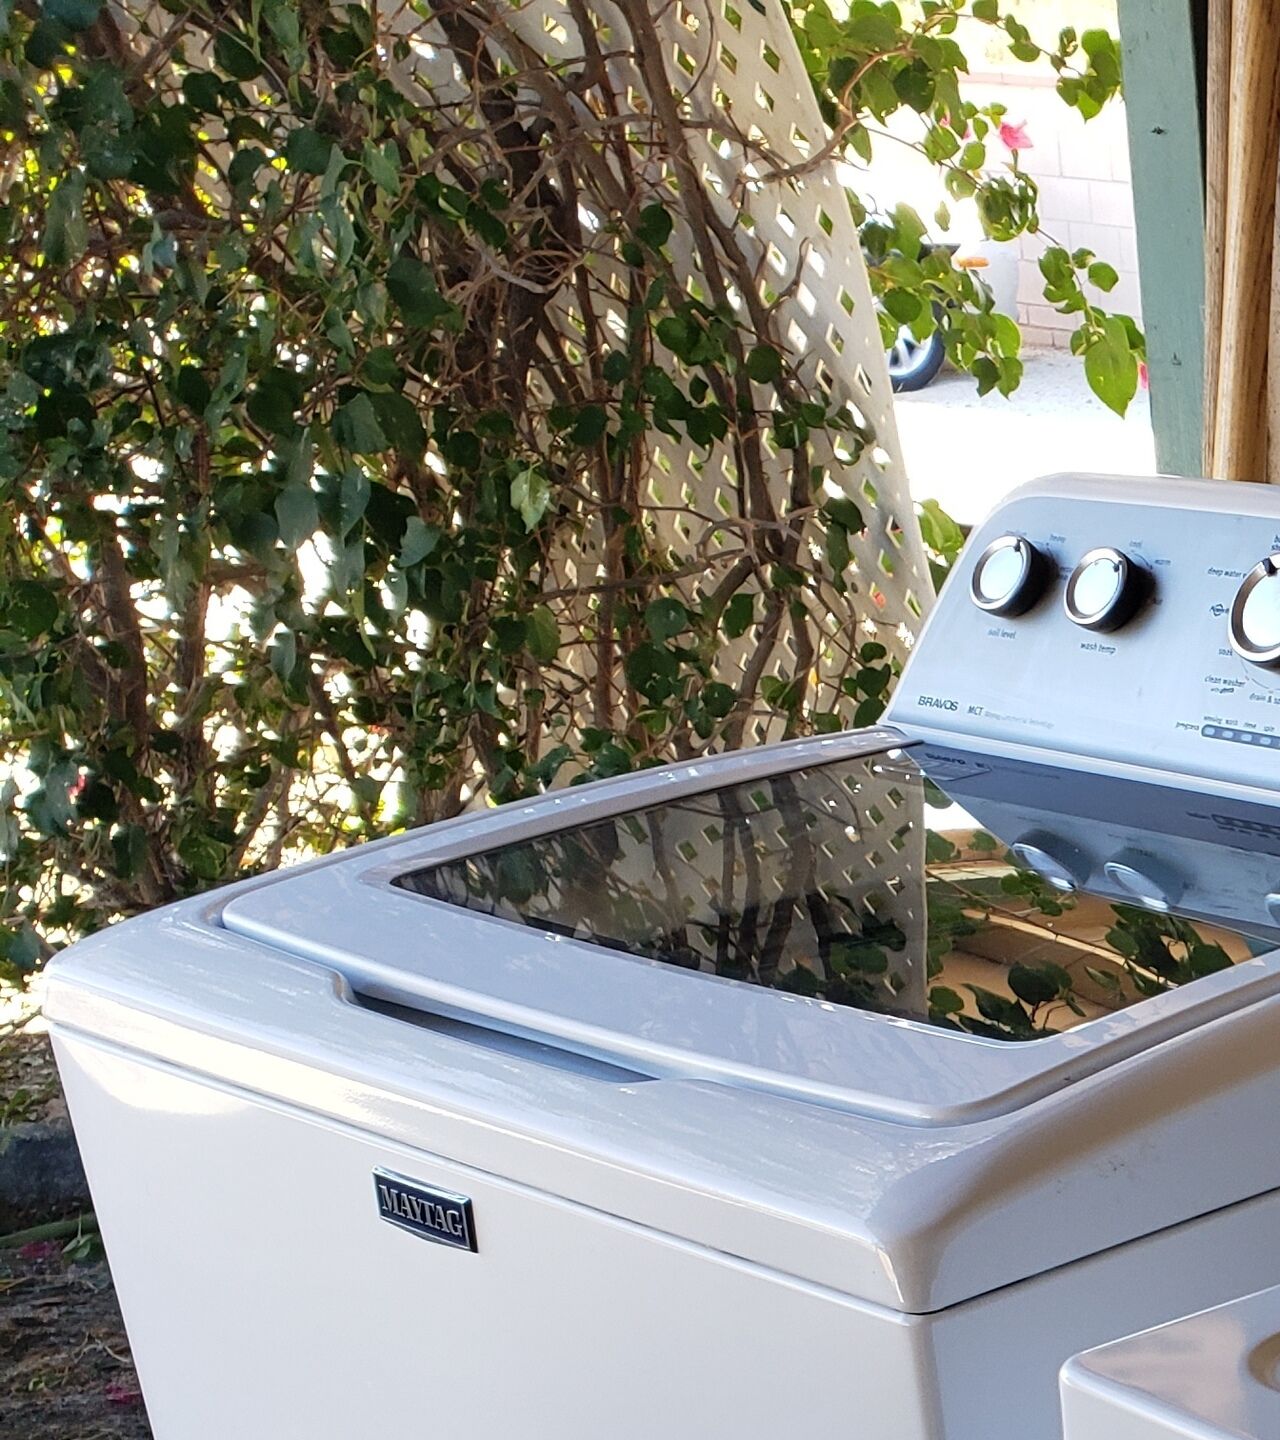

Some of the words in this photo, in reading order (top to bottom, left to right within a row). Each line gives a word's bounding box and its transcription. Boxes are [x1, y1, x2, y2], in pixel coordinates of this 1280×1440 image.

[1080, 641, 1097, 651] wash
[1098, 643, 1116, 655] temp
[918, 695, 959, 711] BRAVOS
[379, 1184, 463, 1237] MAYTAG
